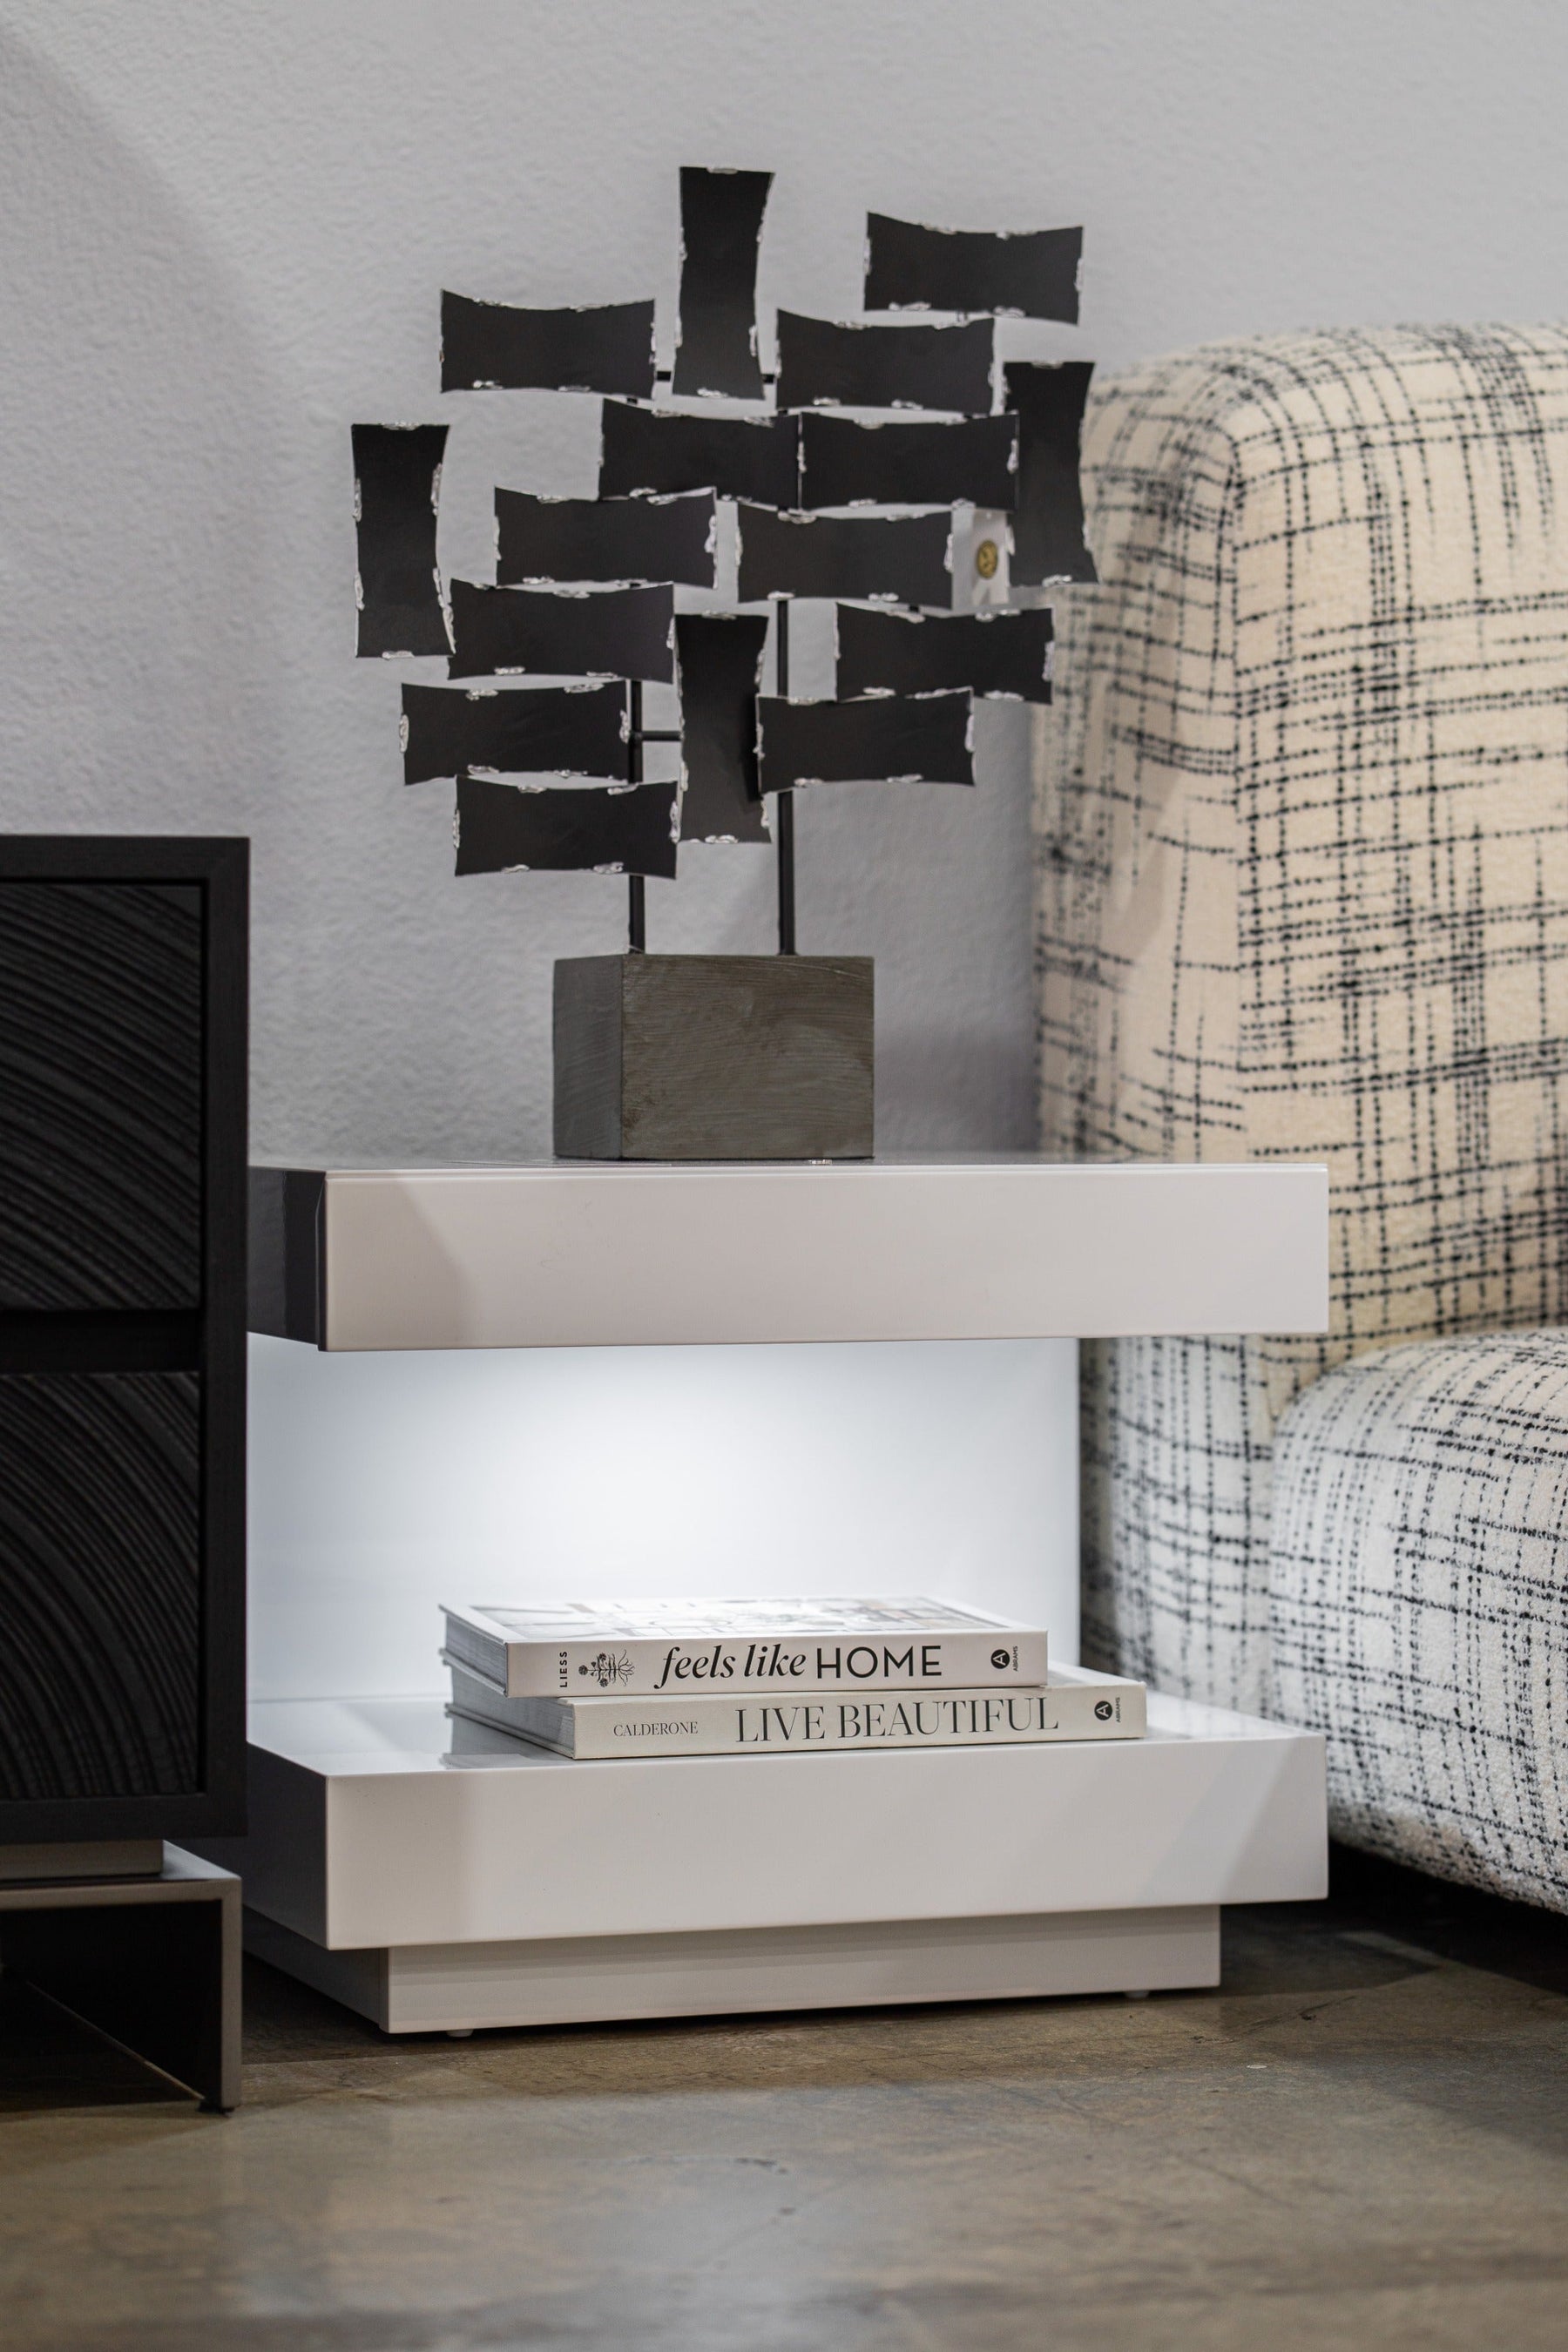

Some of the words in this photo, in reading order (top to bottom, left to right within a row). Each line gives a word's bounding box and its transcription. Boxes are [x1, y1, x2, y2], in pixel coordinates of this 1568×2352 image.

[558, 1651, 568, 1688] LIESS
[652, 1645, 736, 1690] feels
[743, 1643, 807, 1678] like
[816, 1645, 943, 1680] HOME
[613, 1720, 699, 1737] CALDERONE
[734, 1705, 826, 1743] LIVE
[836, 1696, 1059, 1740] BEAUTIFUL
